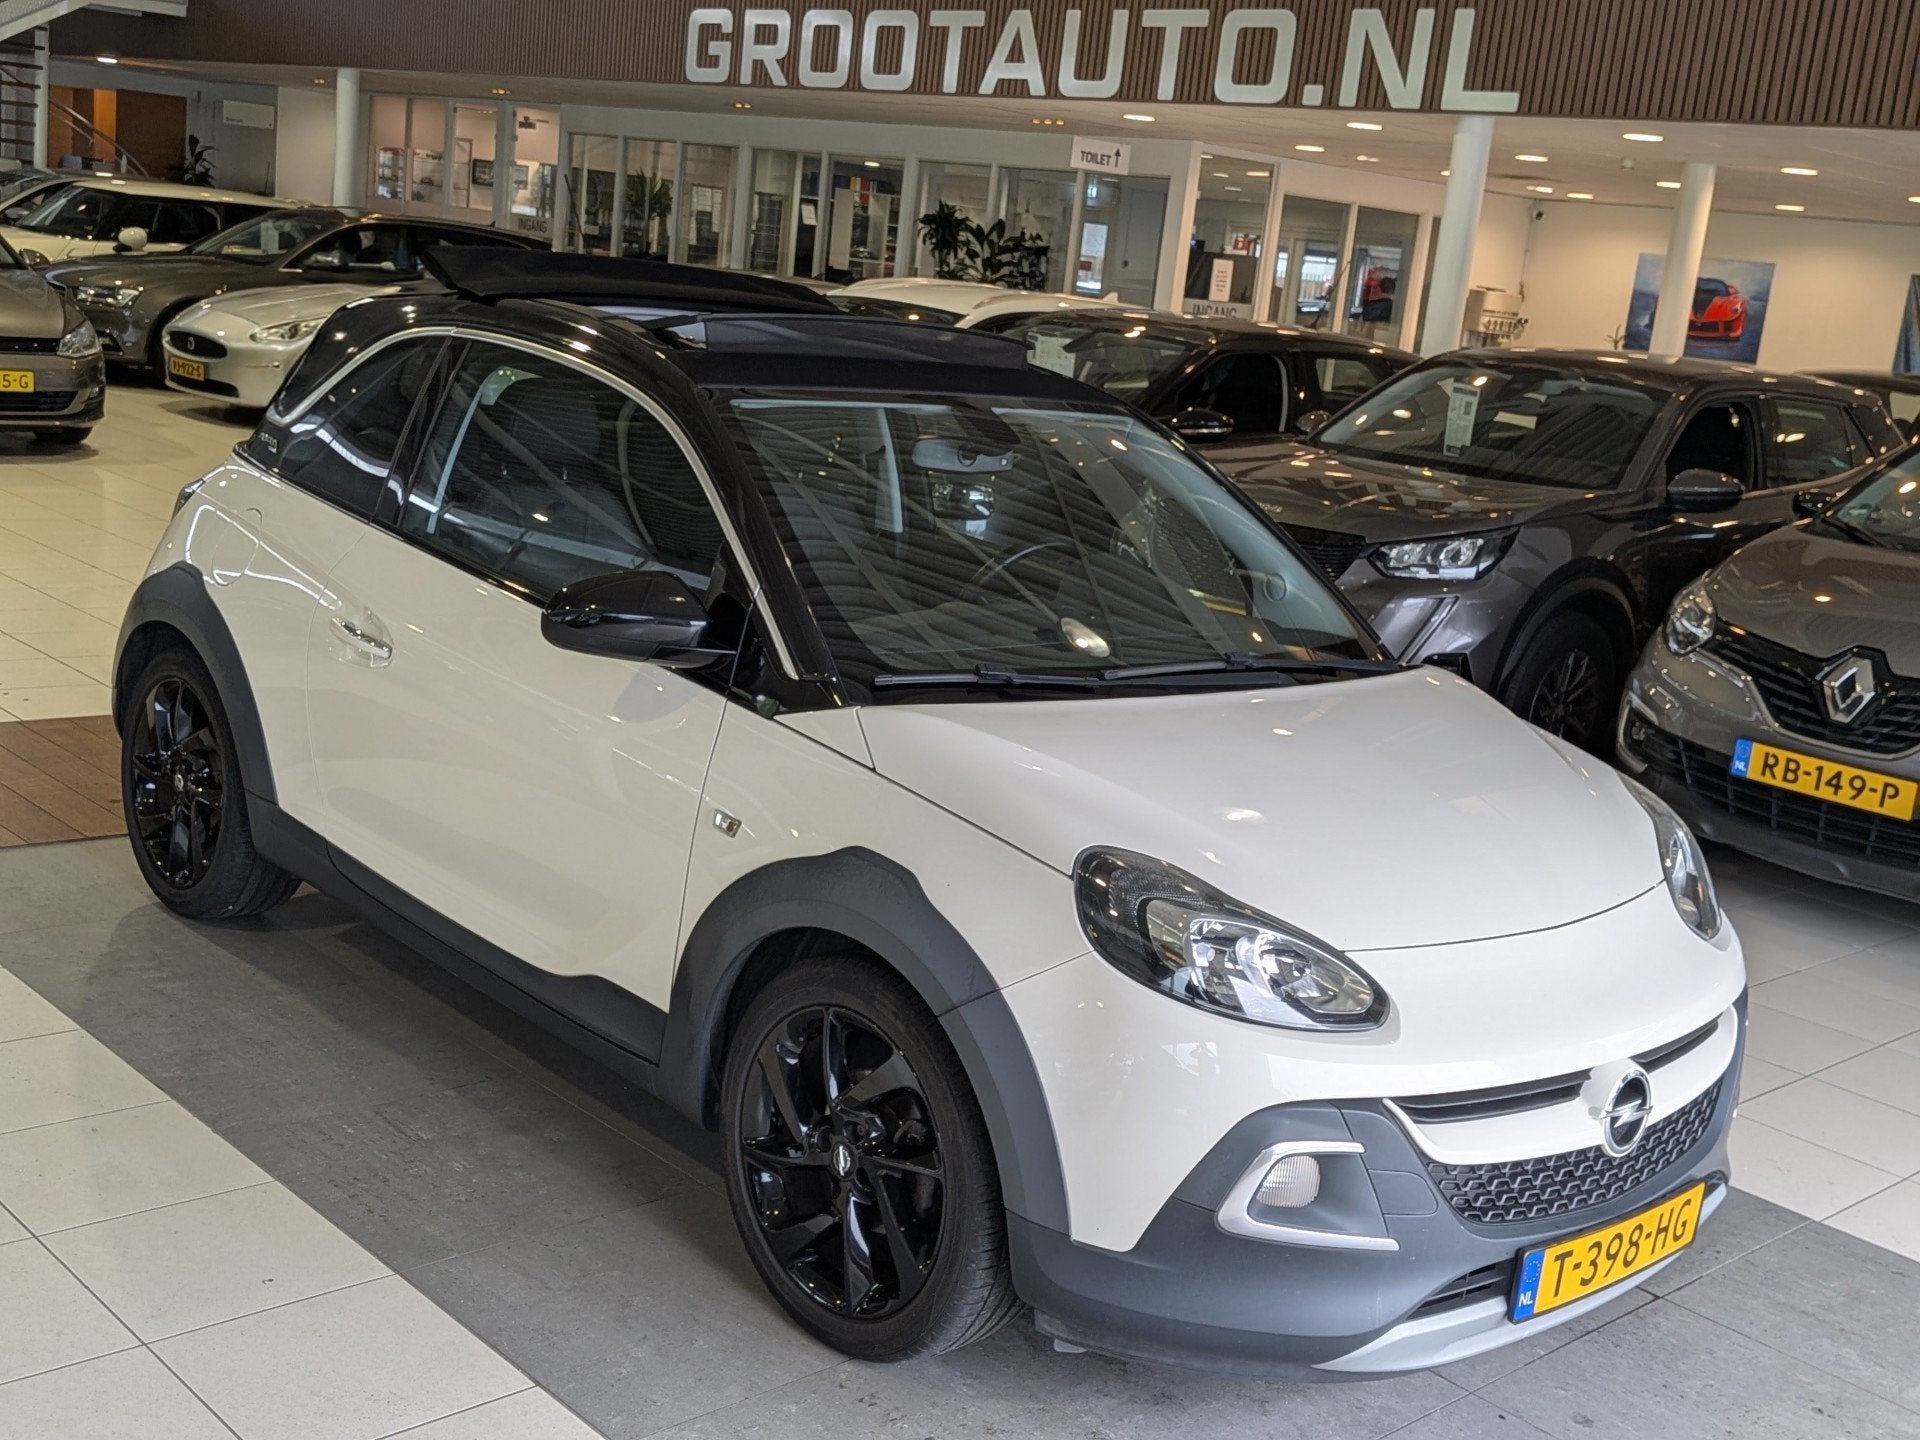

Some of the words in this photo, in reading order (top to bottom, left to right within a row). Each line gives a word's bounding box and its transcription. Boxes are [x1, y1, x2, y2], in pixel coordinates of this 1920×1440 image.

[686, 8, 1520, 113] GROOTAUTO.NL
[1080, 150, 1111, 166] TOILET
[1734, 759, 1746, 772] NL
[1760, 751, 1900, 808] RB-149-P
[1553, 1198, 1692, 1298] T-398-HG
[1518, 1290, 1533, 1307] NL
